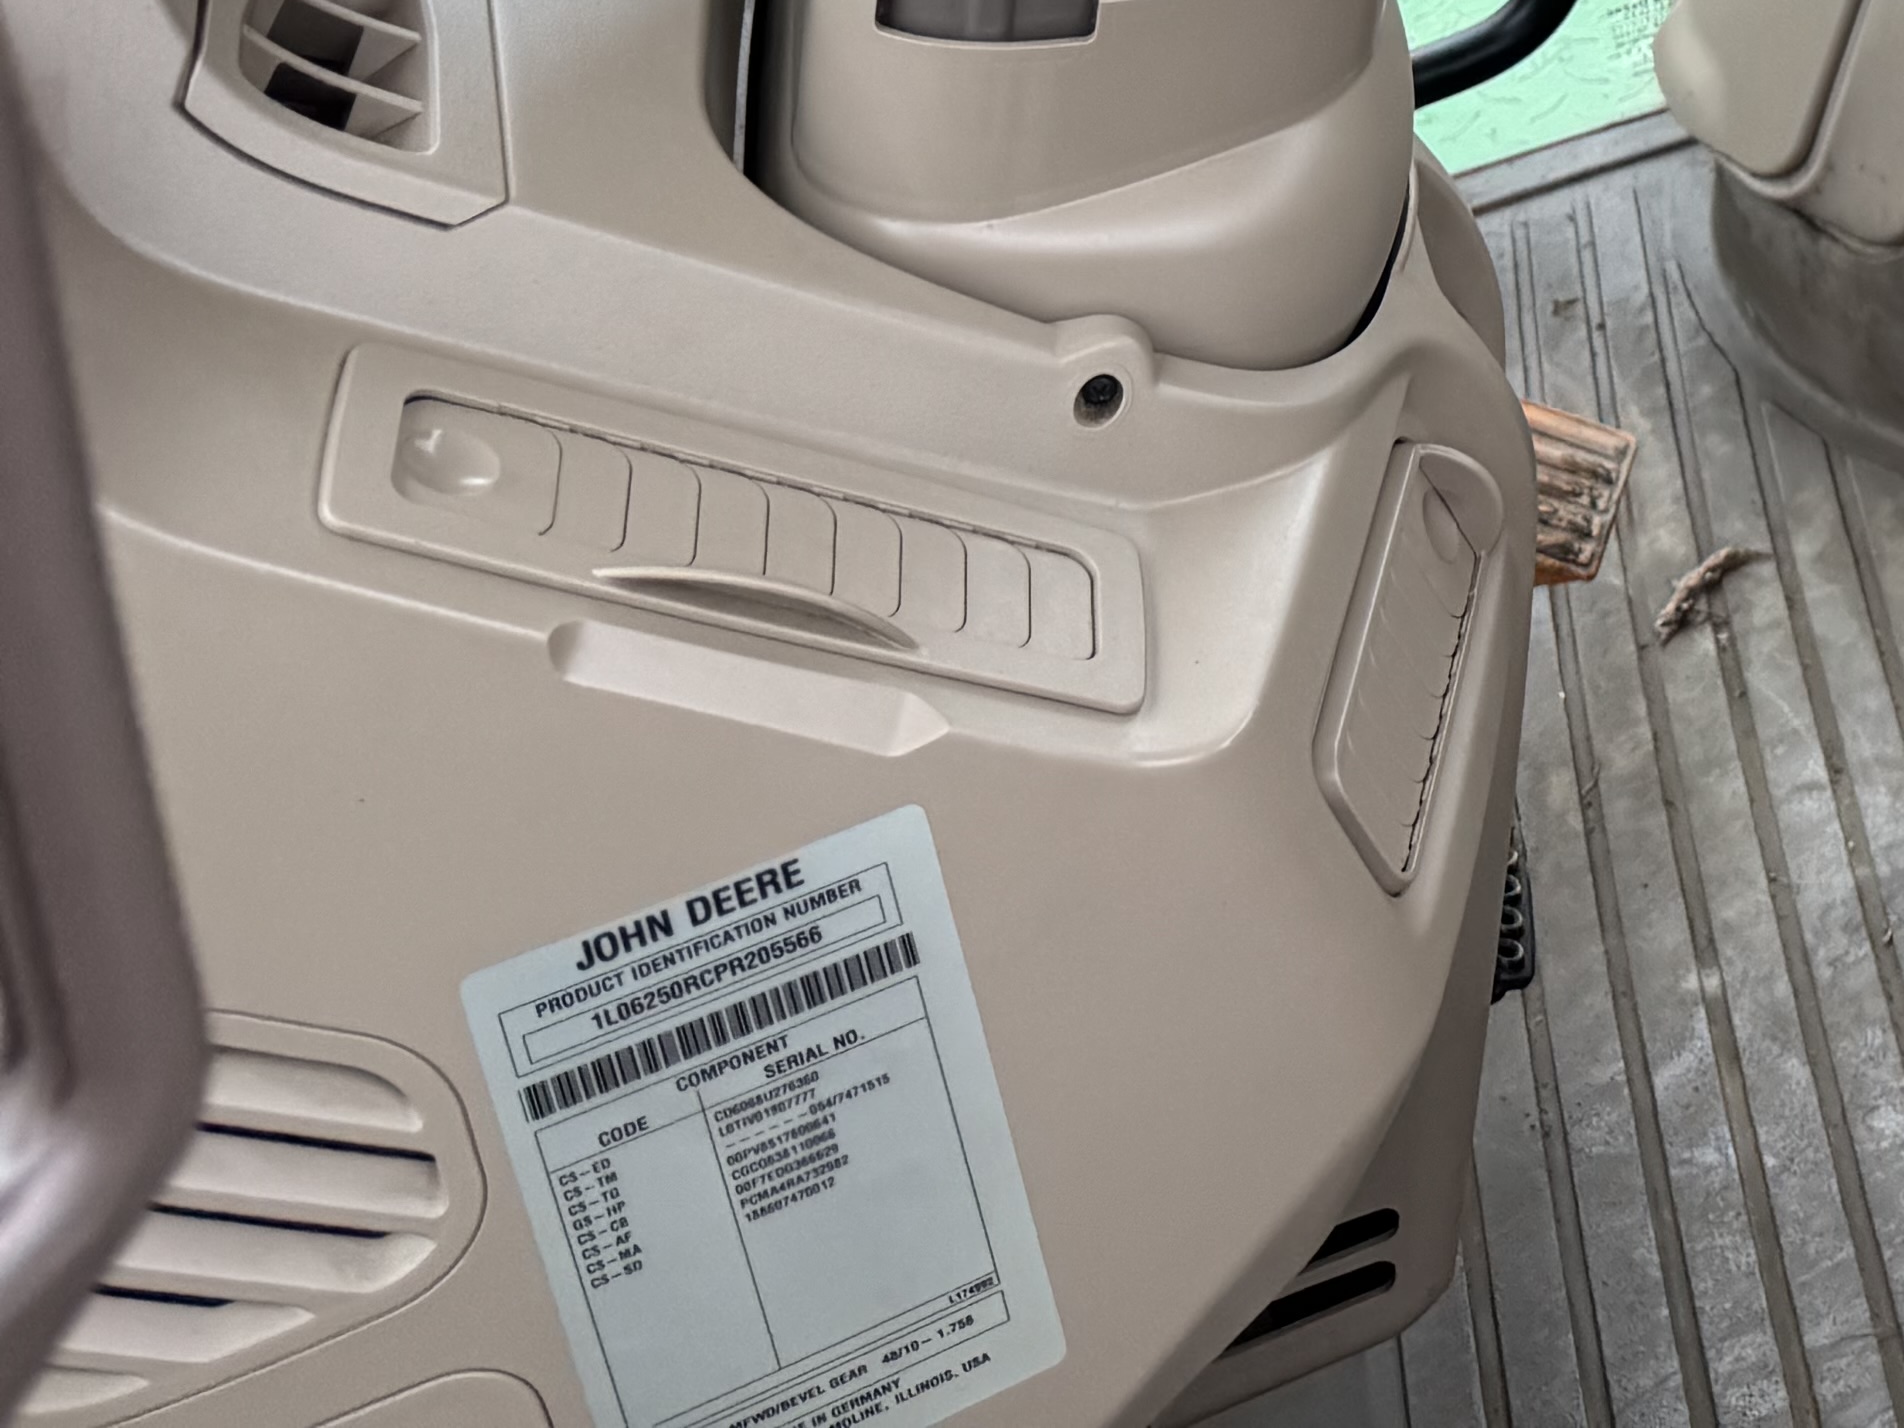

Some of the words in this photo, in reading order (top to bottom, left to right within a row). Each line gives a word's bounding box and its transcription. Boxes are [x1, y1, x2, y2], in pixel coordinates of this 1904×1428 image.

[576, 909, 674, 972] JOHN
[685, 858, 805, 928] DEERE
[534, 972, 625, 1019] PRODUCT
[631, 912, 778, 982] IDENTIFICATION
[783, 878, 863, 922] NUMBER
[590, 925, 823, 1030] 1L06250RCPR205566
[675, 1034, 790, 1093] COMPONENT
[763, 1044, 828, 1079] SERIAL
[833, 1029, 866, 1051] NO.
[597, 1115, 650, 1148] CODE
[829, 1364, 868, 1389] GEAR
[961, 1353, 991, 1373] USA
[811, 1412, 827, 1428] IN
[831, 1377, 900, 1418] GERMANY
